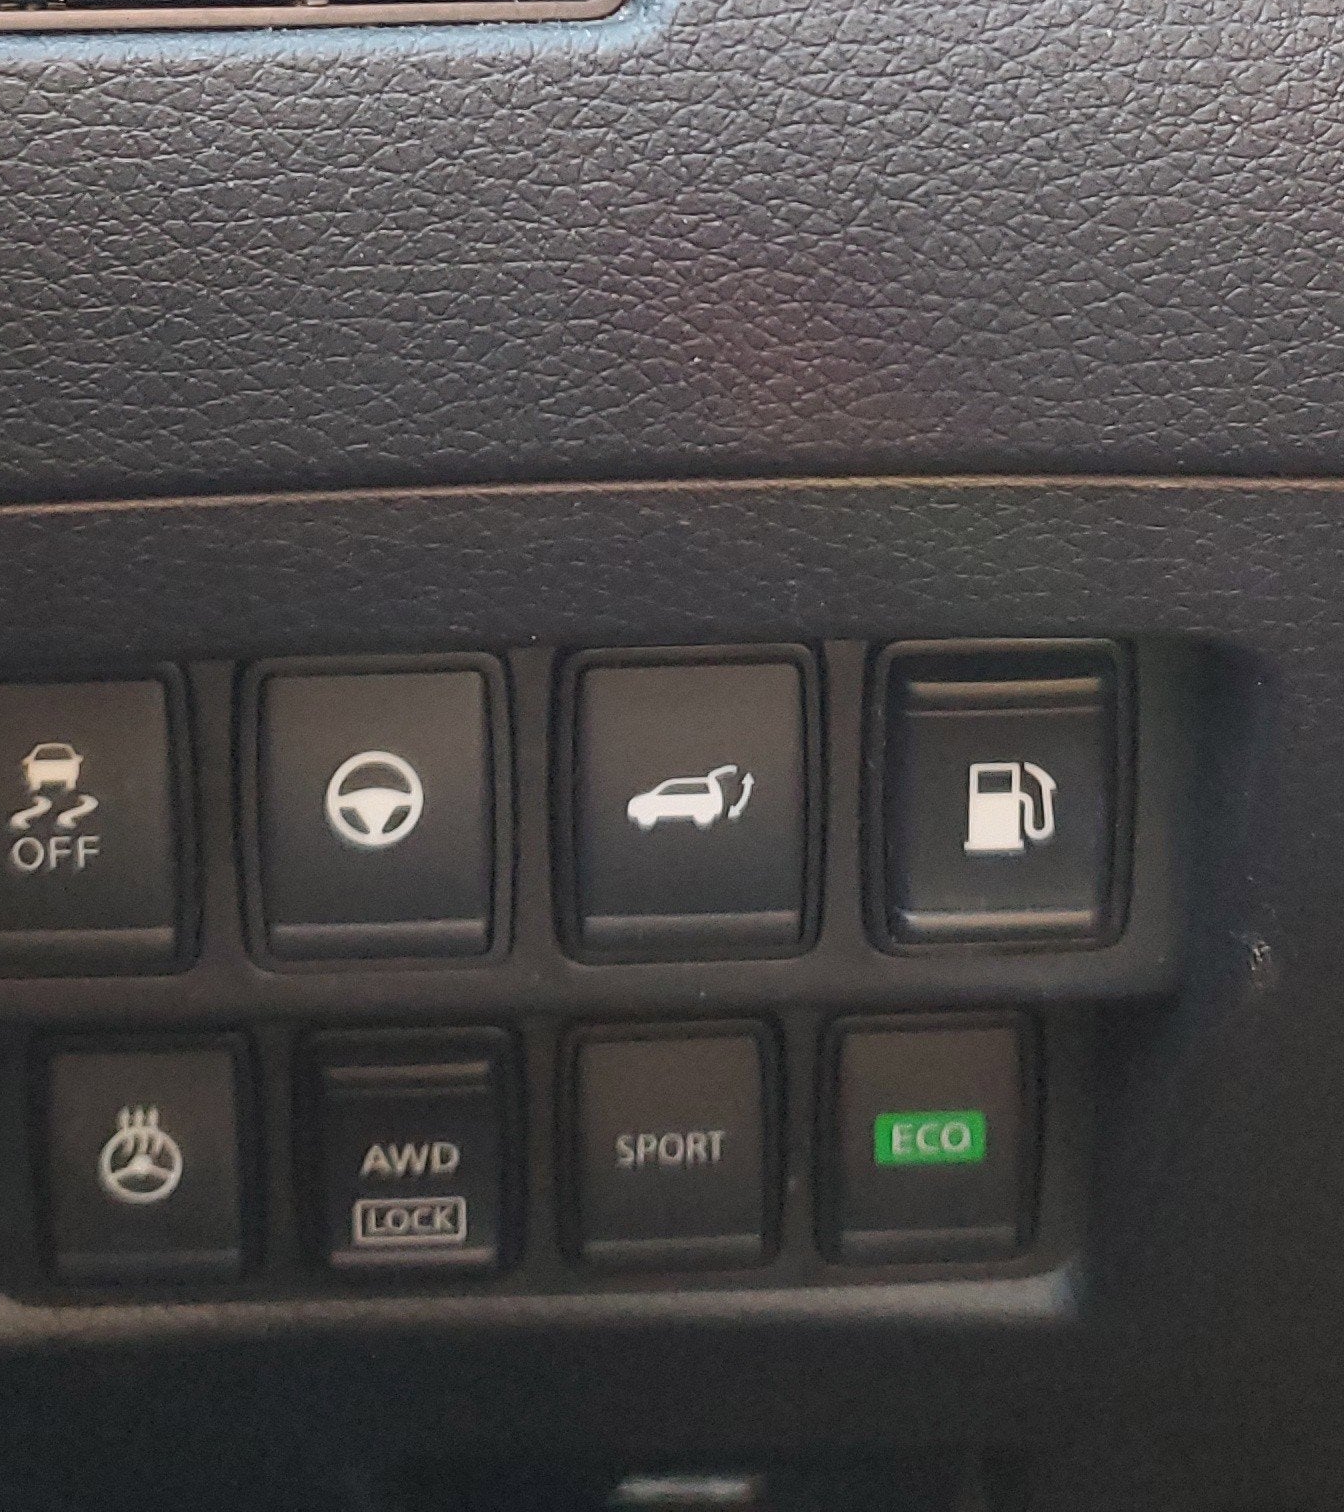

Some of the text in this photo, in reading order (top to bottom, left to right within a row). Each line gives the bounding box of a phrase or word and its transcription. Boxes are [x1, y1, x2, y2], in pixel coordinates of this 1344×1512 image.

[11, 836, 100, 871] OFF
[615, 1130, 725, 1167] SPORT
[892, 1121, 972, 1156] ECO
[360, 1142, 460, 1176] AWD
[365, 1205, 454, 1236] LOCK
